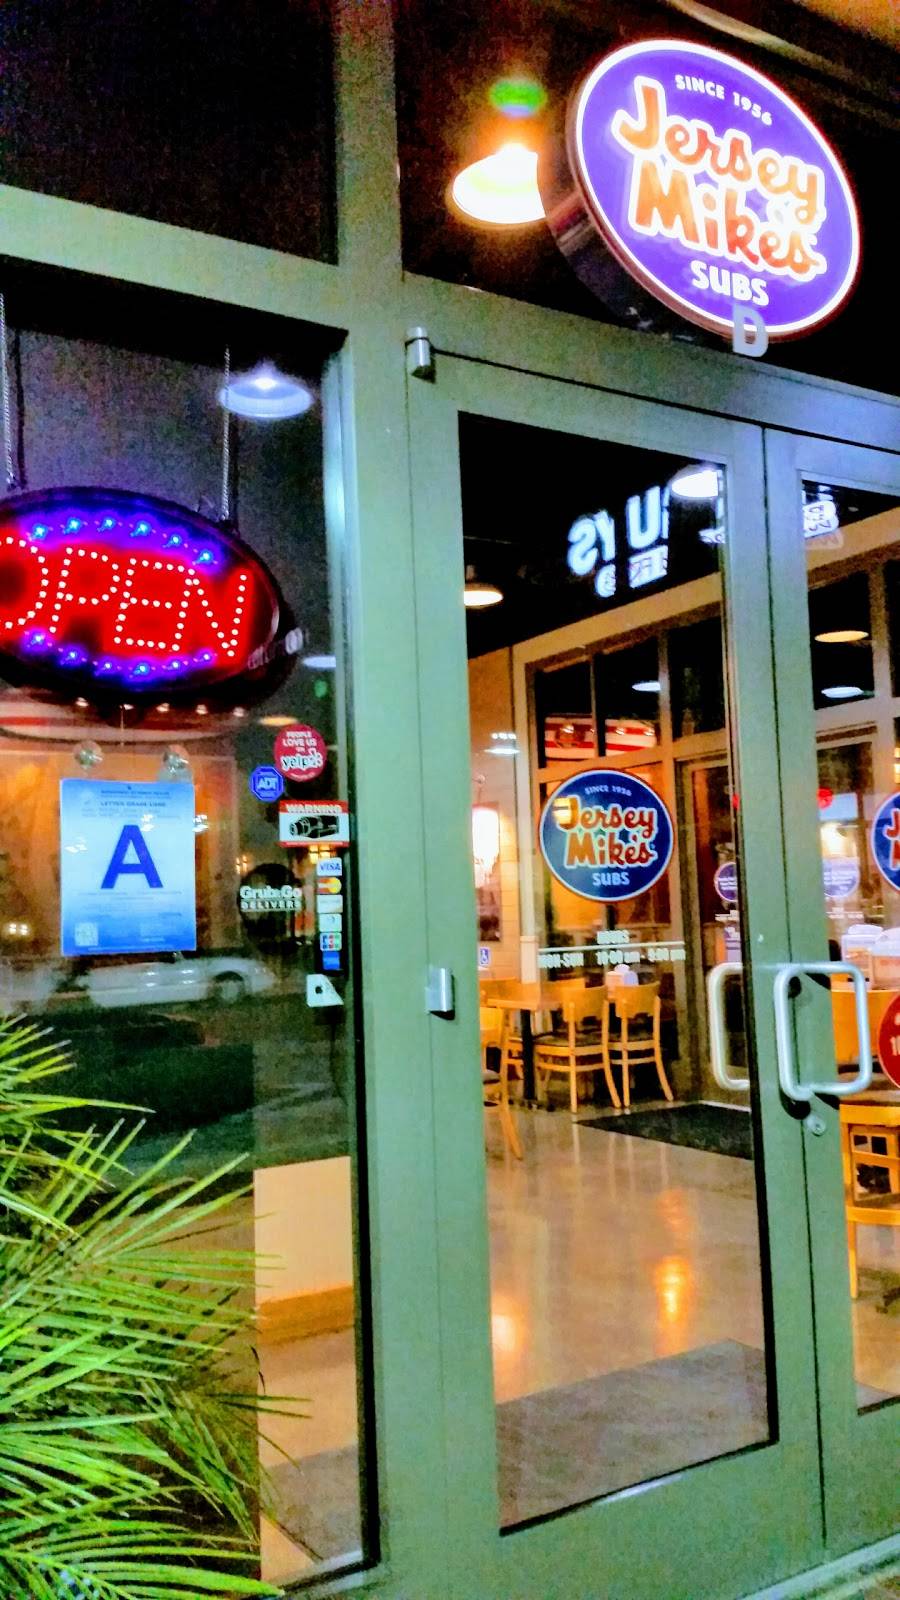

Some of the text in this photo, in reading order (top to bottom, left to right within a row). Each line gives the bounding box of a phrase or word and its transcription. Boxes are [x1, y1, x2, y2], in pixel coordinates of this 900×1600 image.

[675, 74, 773, 126] SINCE 1956
[612, 76, 825, 228] Jersey
[690, 260, 769, 306] SUBS
[555, 795, 658, 840] Jersey
[101, 825, 163, 889] A
[320, 863, 341, 871] VISA
[564, 831, 658, 869] Mike's
[592, 872, 630, 886] SUBS
